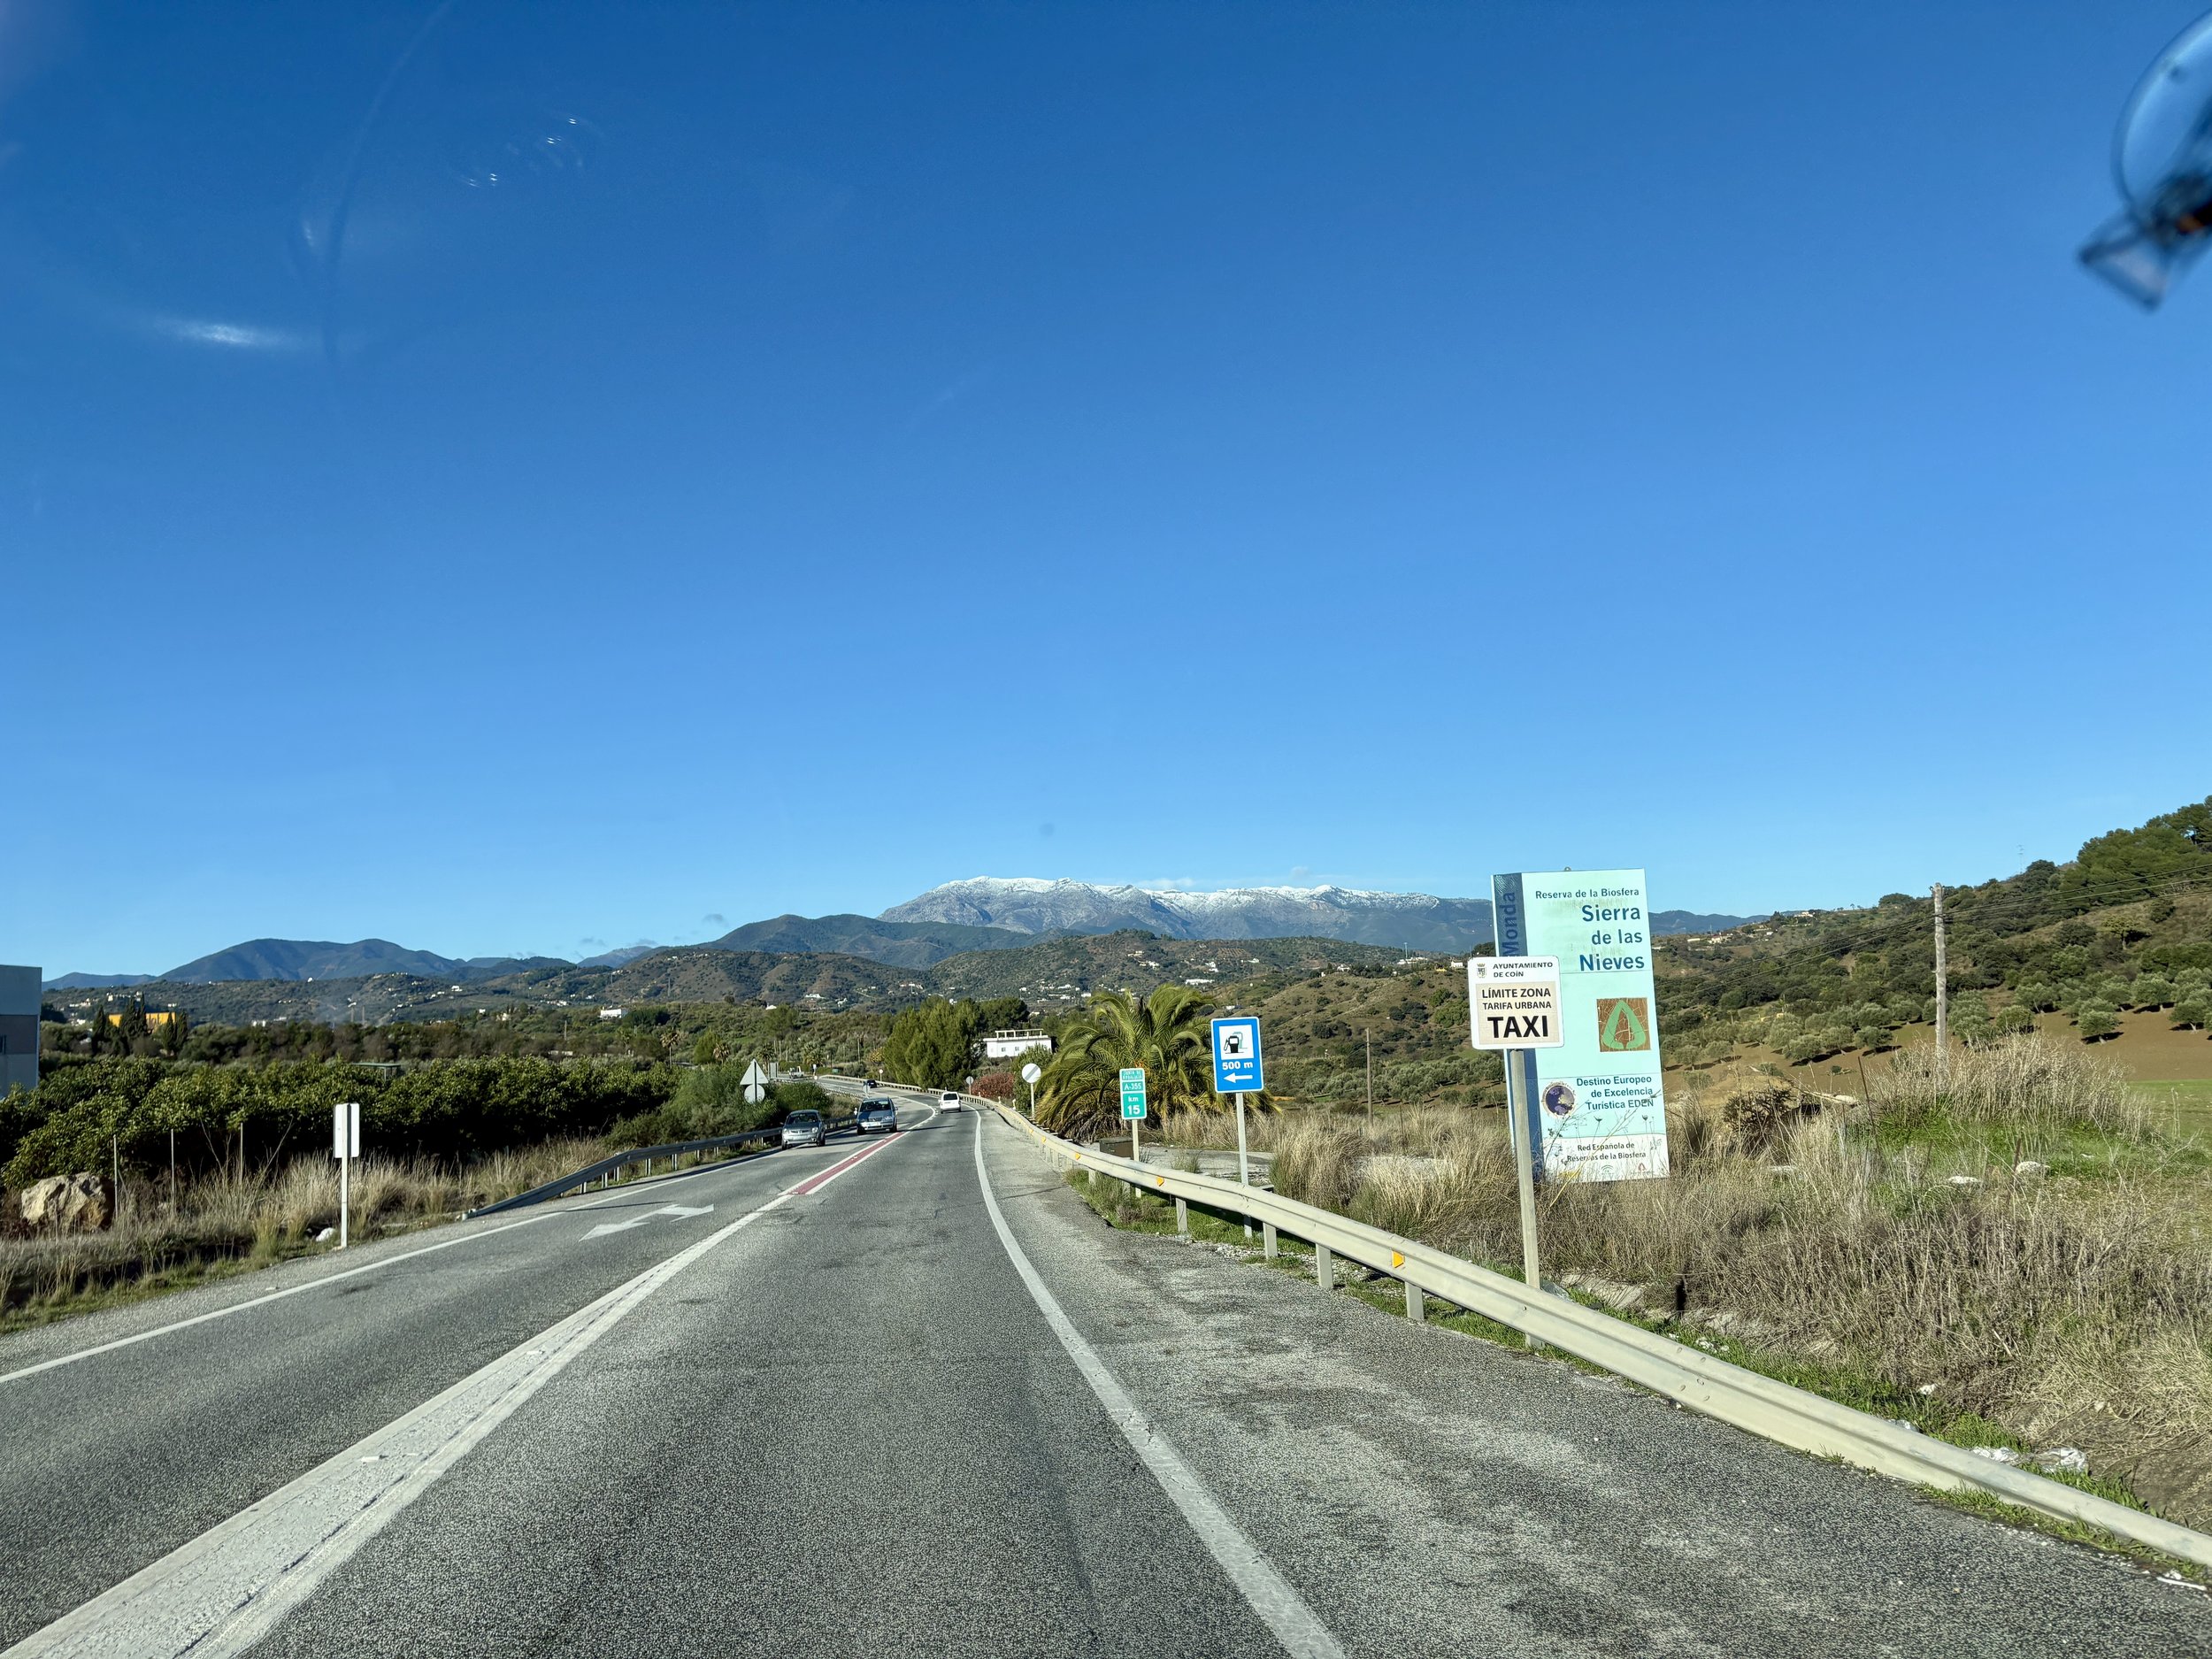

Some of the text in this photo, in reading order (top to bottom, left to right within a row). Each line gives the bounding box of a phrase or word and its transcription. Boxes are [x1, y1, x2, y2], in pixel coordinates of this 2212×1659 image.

[1535, 887, 1640, 899] Reserva de la Biosfera
[1581, 904, 1640, 922] Sierra
[1500, 892, 1519, 956] Monda
[1592, 929, 1643, 945] de las
[1579, 953, 1645, 972] Nieves
[1482, 987, 1551, 998] LÍMITE ZONA
[1482, 1001, 1552, 1010] TARIFA URBANA
[1486, 1015, 1548, 1039] TAXI
[1221, 1061, 1240, 1071] 500
[1576, 1076, 1652, 1087] Destino Europeo
[1591, 1087, 1653, 1098] de Excelencia
[1628, 1099, 1654, 1109] EDEN
[1127, 1104, 1141, 1116] 15
[1618, 1151, 1647, 1160] Biosfera
